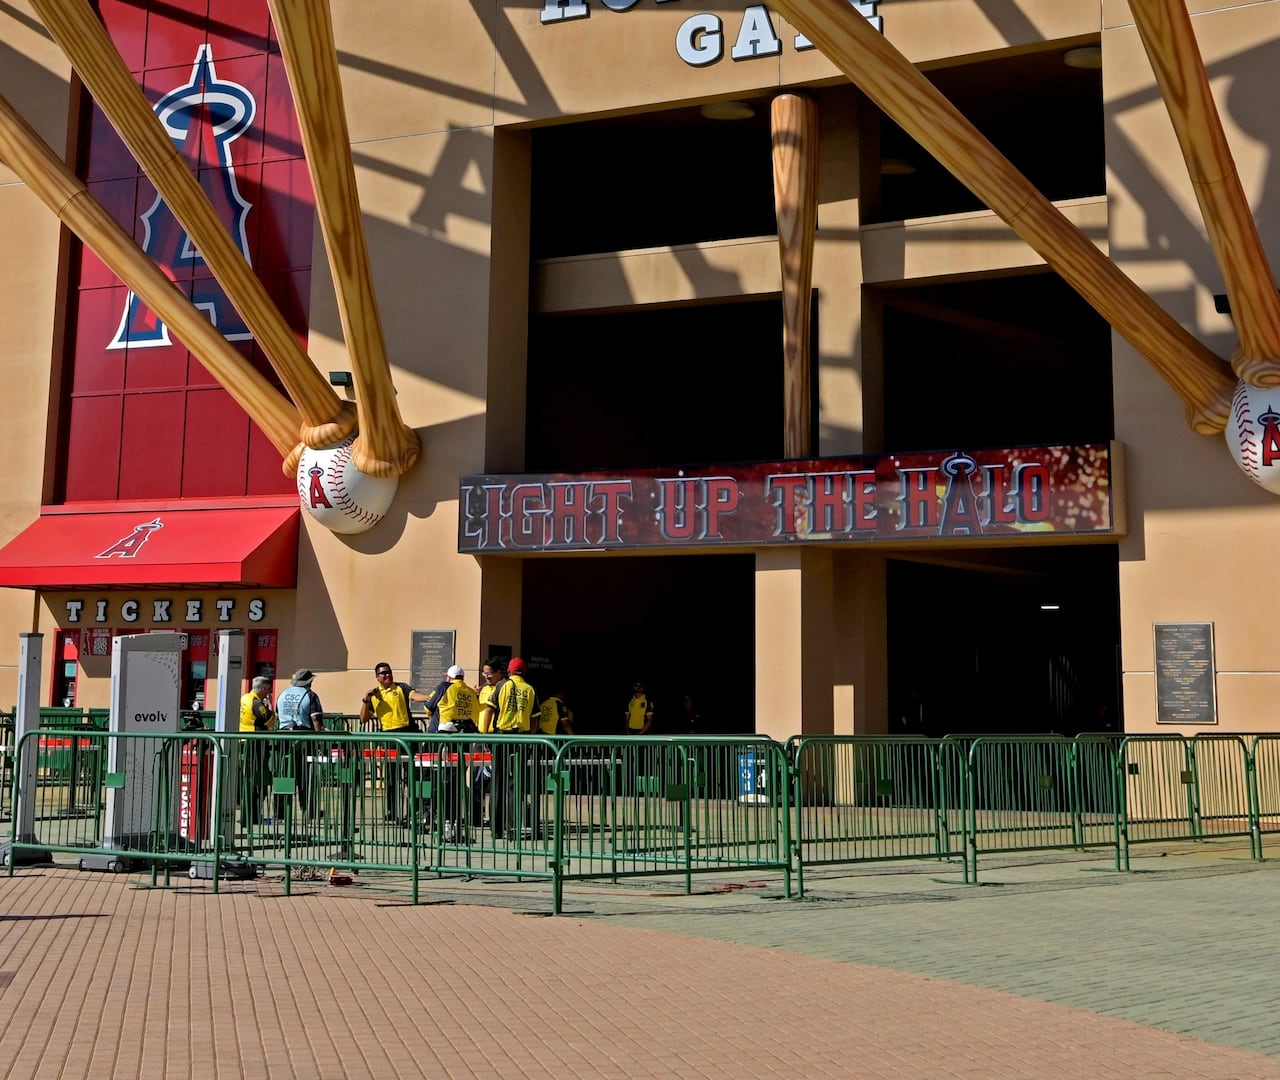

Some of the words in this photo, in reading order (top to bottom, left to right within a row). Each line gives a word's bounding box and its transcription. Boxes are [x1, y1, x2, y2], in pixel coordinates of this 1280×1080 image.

[655, 476, 744, 541] UP
[765, 470, 878, 537] THE
[897, 451, 1052, 537] HALO
[66, 600, 266, 622] TICKETS
[285, 693, 301, 702] CSC
[456, 693, 472, 702] CSC
[134, 711, 168, 722] evolv
